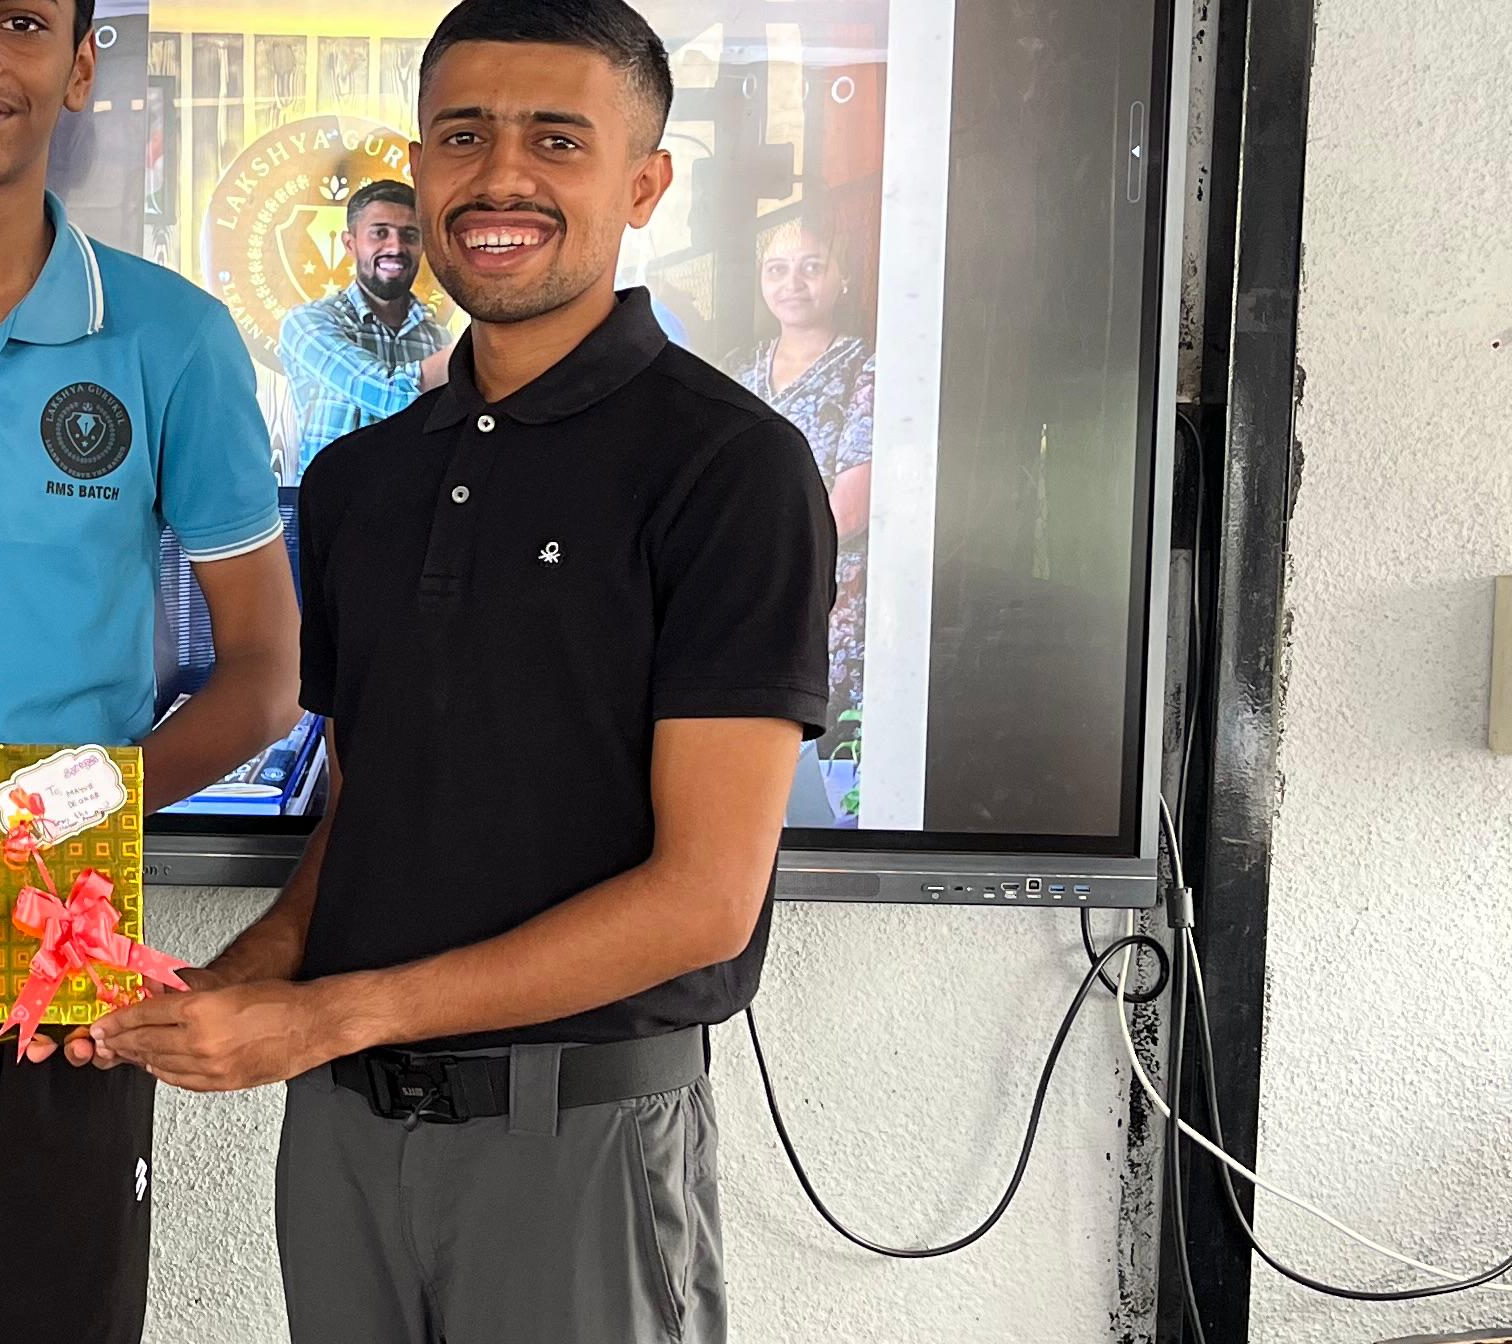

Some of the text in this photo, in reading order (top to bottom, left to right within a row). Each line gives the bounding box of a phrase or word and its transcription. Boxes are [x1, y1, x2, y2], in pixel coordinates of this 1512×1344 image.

[216, 128, 330, 231] LAKSHYA
[46, 383, 126, 425] LAKSHYA GURUKUL
[46, 480, 120, 501] RMS BATCH
